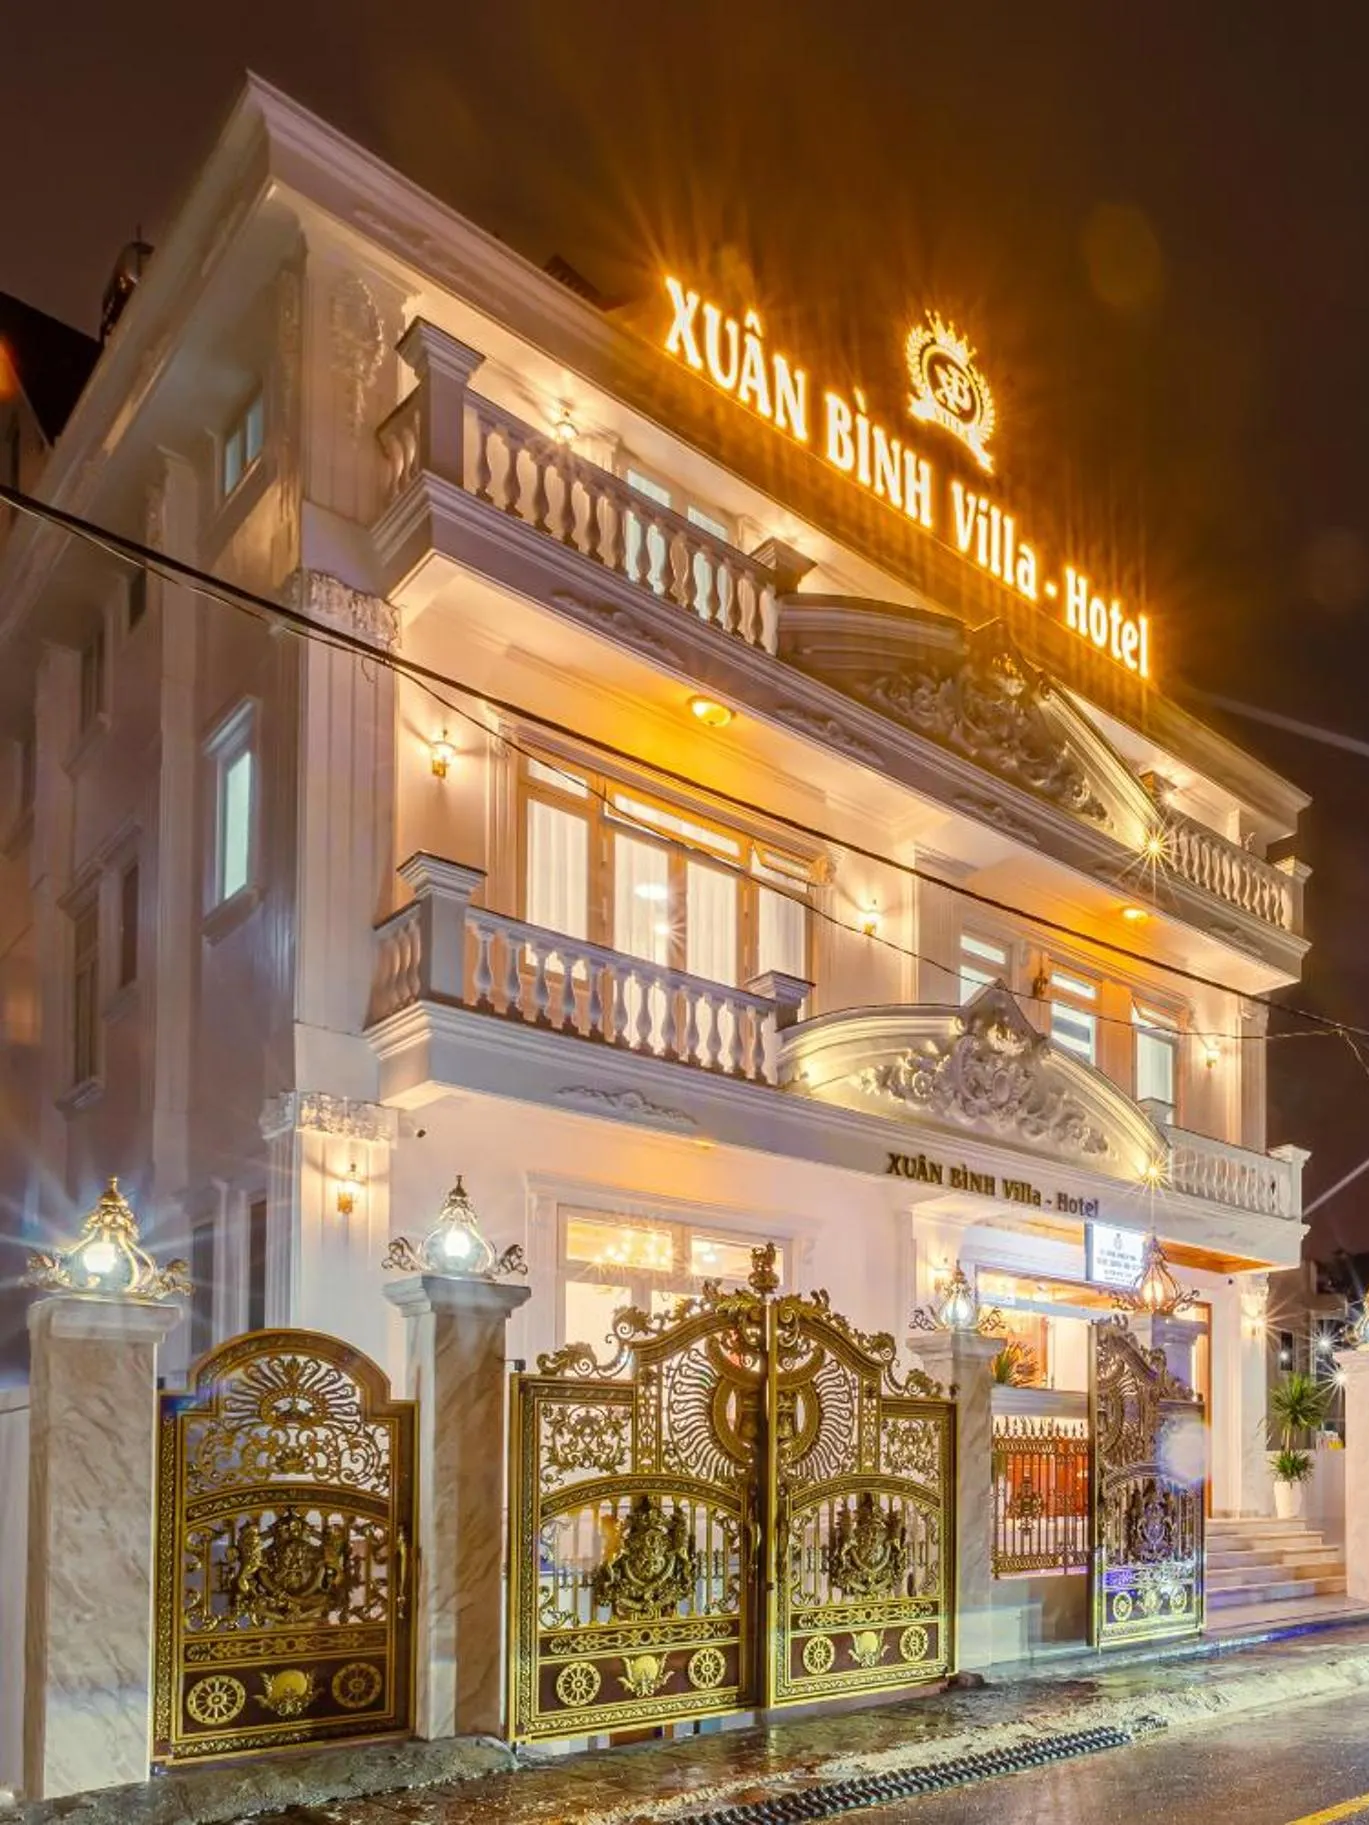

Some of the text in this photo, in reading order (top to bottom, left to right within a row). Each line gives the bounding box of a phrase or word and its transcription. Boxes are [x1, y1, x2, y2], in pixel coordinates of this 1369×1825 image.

[664, 276, 807, 441] XUÂN
[824, 387, 933, 528] BÌNH
[951, 480, 1038, 601] Villa
[1065, 566, 1149, 679] Hotel
[886, 1152, 943, 1185] XUÂN
[950, 1163, 996, 1196] BÌNH
[1002, 1178, 1042, 1207] Villa
[1056, 1192, 1100, 1218] Hotel
